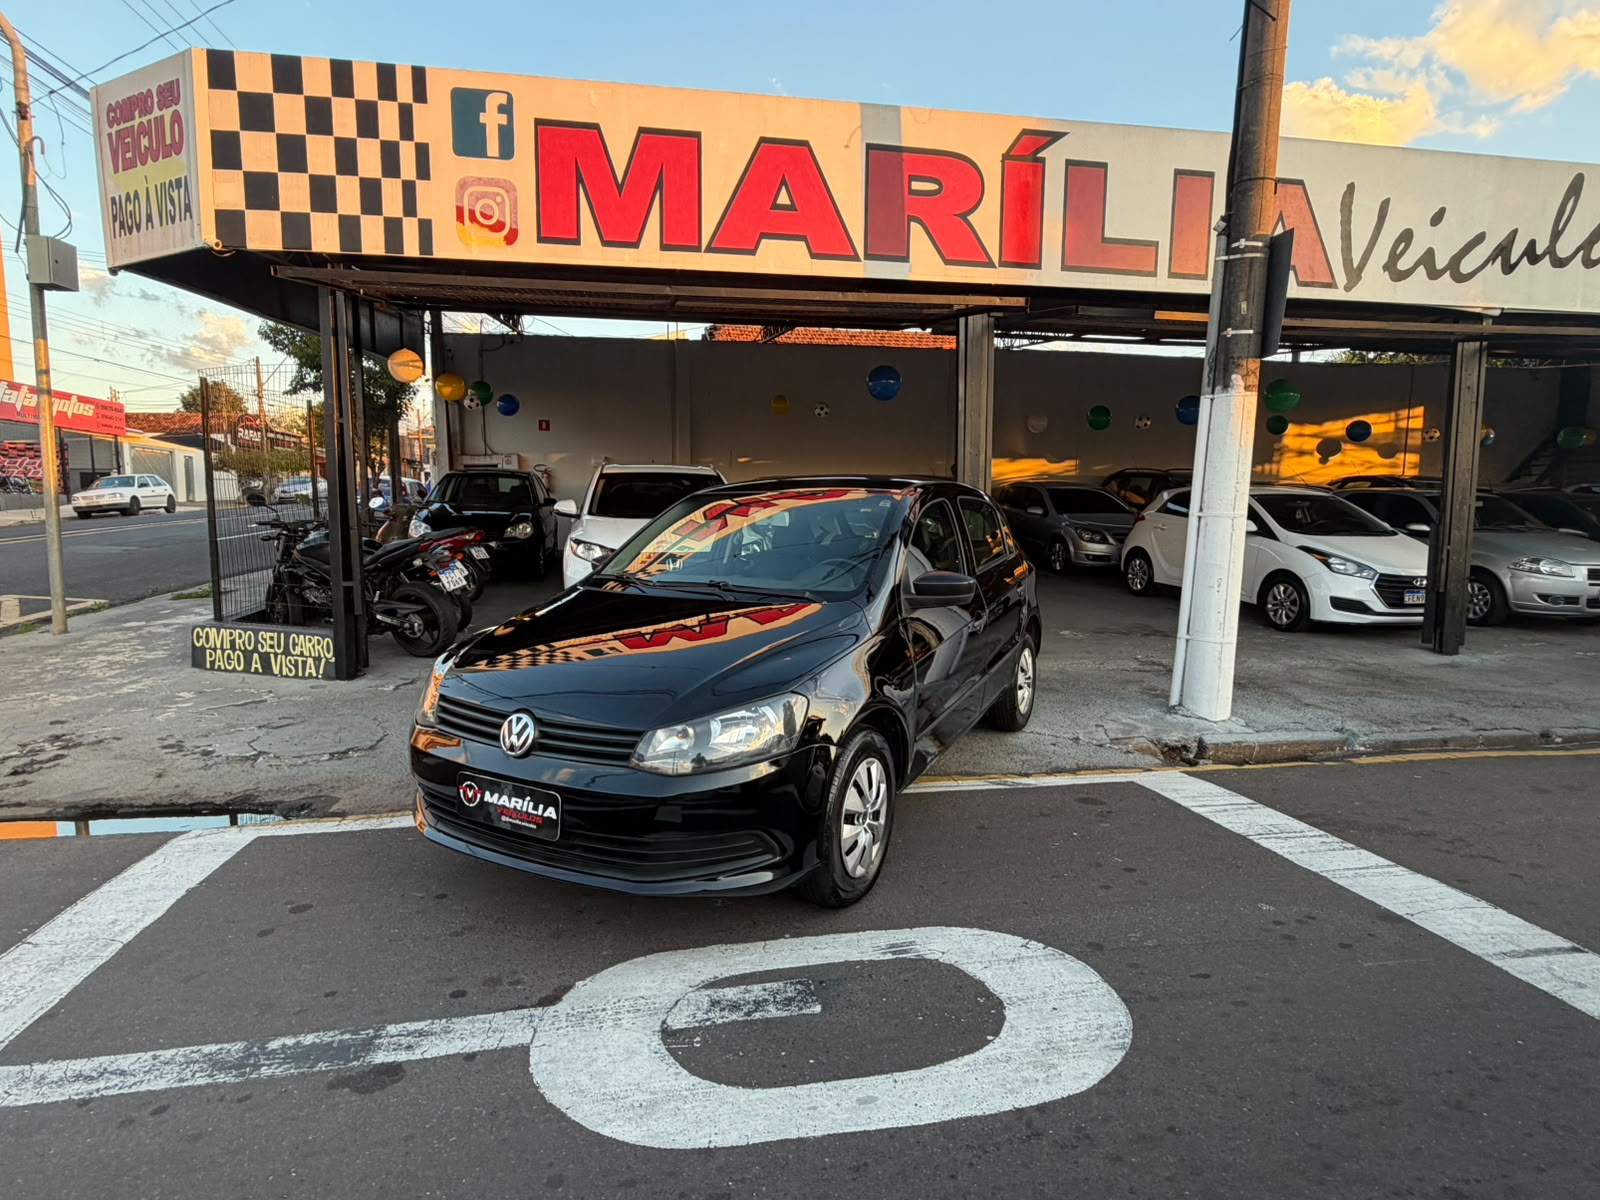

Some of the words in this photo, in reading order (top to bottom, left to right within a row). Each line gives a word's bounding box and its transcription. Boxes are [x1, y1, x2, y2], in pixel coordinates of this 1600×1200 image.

[106, 88, 154, 129] COMPRO
[156, 78, 181, 111] SEU
[107, 109, 185, 174] VEICULO
[111, 189, 142, 239] PAGO
[144, 175, 154, 231] À
[154, 175, 193, 228] VISTA
[193, 627, 255, 650] COMPRO
[257, 631, 285, 654] SEU
[205, 649, 245, 671] PAGO
[251, 652, 262, 673] A
[270, 653, 327, 679] VISTA!
[484, 790, 558, 820] MARÍLIA
